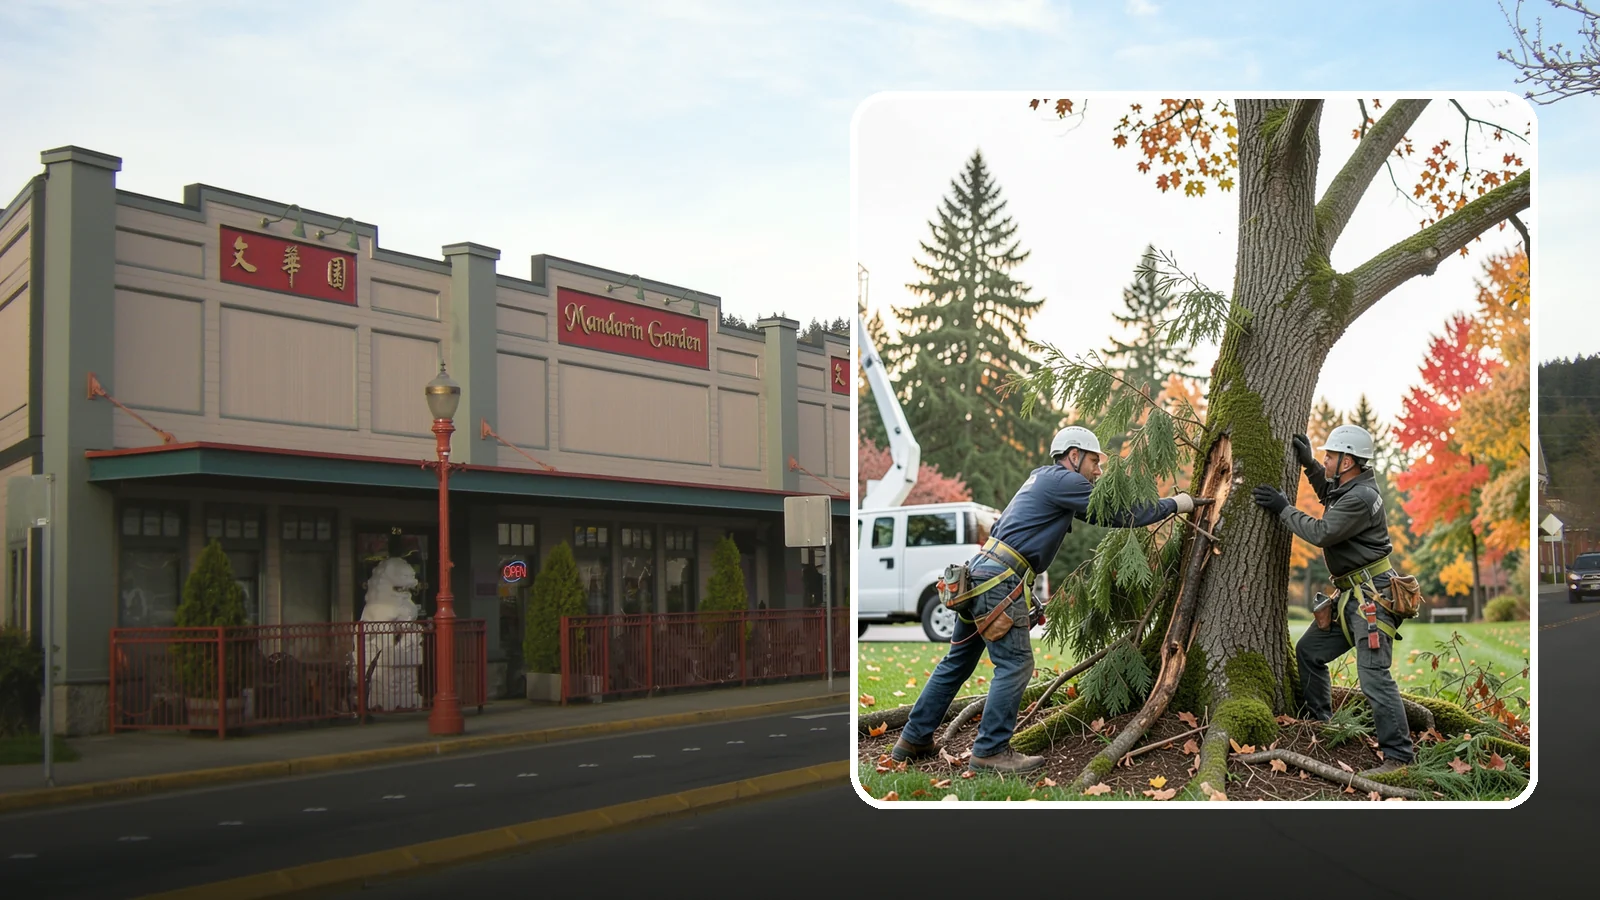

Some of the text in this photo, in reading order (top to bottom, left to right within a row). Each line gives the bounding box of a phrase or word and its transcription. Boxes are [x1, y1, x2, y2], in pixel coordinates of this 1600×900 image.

[230, 235, 347, 291] 文華園
[564, 302, 702, 352] Mandarin Garden
[503, 565, 527, 578] OPEN
